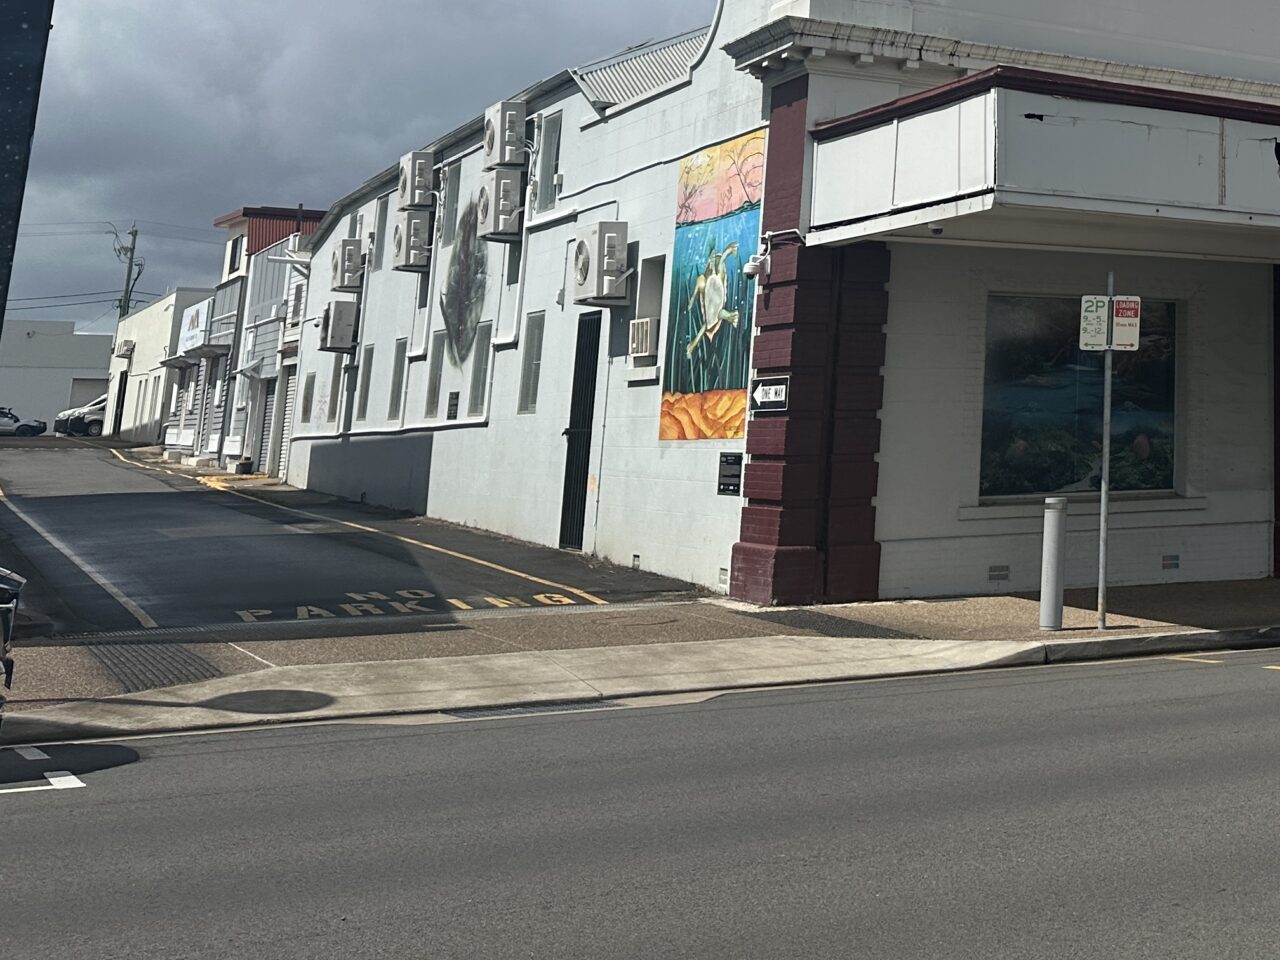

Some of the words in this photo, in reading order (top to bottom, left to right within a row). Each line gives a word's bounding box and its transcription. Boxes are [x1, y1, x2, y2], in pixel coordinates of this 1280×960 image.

[1084, 300, 1106, 313] 2P
[761, 388, 772, 400] ONE
[774, 387, 784, 400] WAY
[344, 590, 436, 602] NO
[234, 593, 577, 623] PARKING
